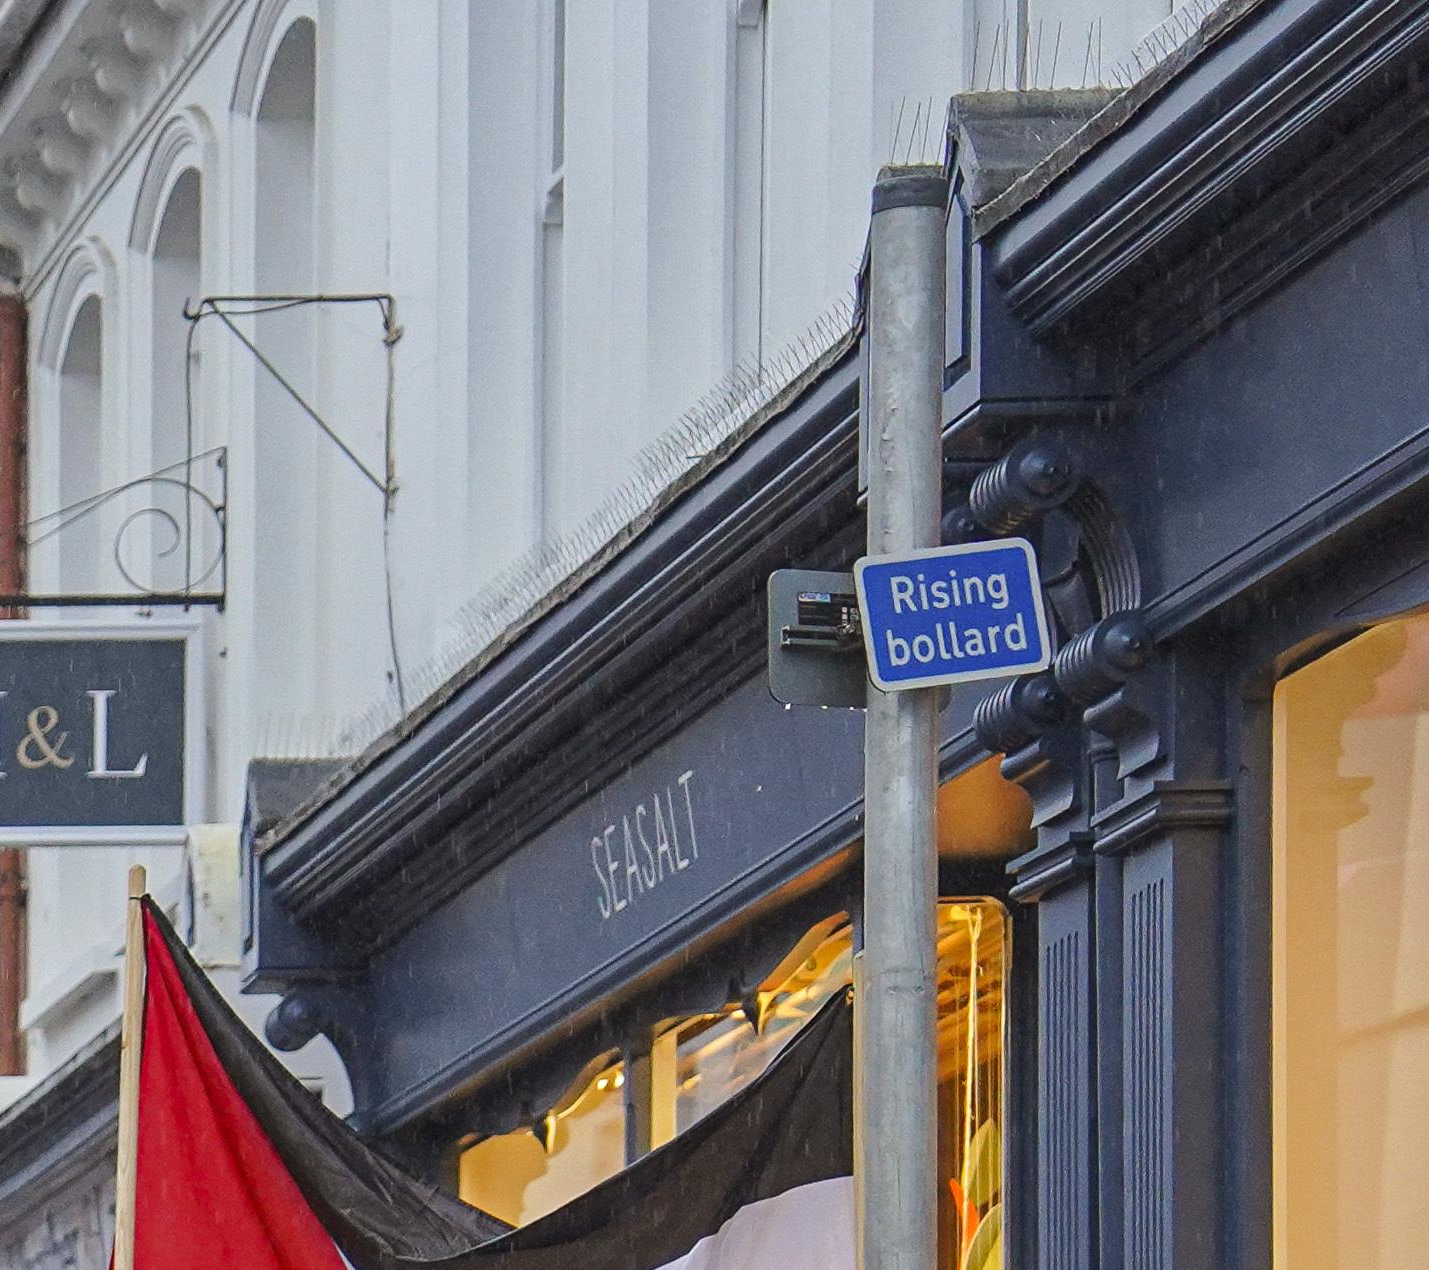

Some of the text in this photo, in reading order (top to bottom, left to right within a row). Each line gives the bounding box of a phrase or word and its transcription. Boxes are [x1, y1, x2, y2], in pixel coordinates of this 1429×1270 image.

[889, 569, 1009, 614] Rising
[886, 613, 1027, 667] bollard
[592, 770, 698, 919] SEASALT
